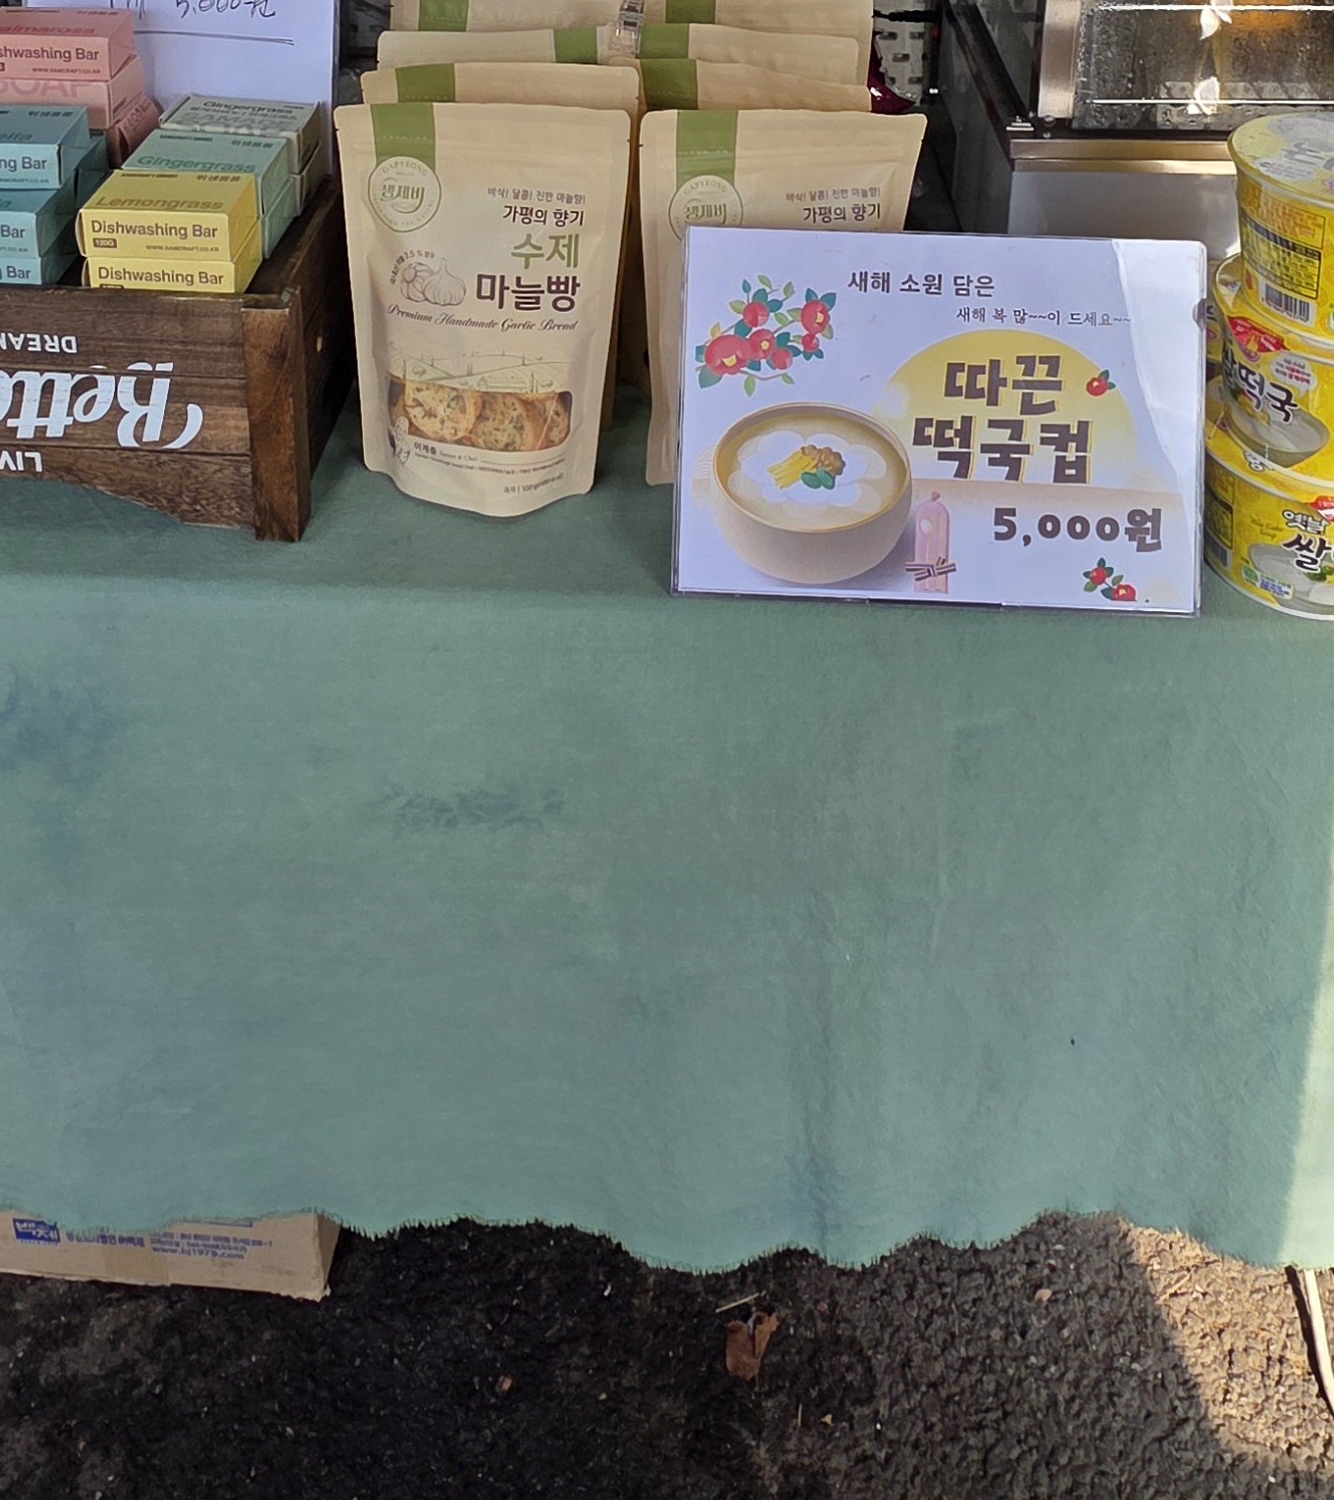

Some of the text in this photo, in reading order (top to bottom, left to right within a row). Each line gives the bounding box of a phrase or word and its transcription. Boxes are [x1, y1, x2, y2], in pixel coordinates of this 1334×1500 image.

[75, 48, 100, 61] Bar
[21, 156, 48, 170] Bar
[136, 154, 257, 174] Gingergrass
[96, 196, 224, 211] Lemongrass
[801, 202, 882, 224] 가평의 향기
[502, 205, 585, 228] 가평의 향기
[0, 224, 26, 240] Bar
[91, 219, 218, 240] Dishwashing Bar
[95, 239, 115, 247] 120G
[510, 233, 580, 270] 수제
[6, 265, 31, 280] Bar
[98, 266, 225, 286] Dishwashing Bar
[475, 273, 581, 313] 마늘빵
[847, 269, 996, 299] 새해 소원 담은
[387, 303, 579, 333] Premium Handmade Garlic Bread
[956, 305, 987, 324] 새해
[991, 306, 1008, 326] 복
[942, 352, 1066, 417] 따끈
[911, 414, 1093, 485] 떡국컵
[992, 505, 1165, 554] 5,000원
